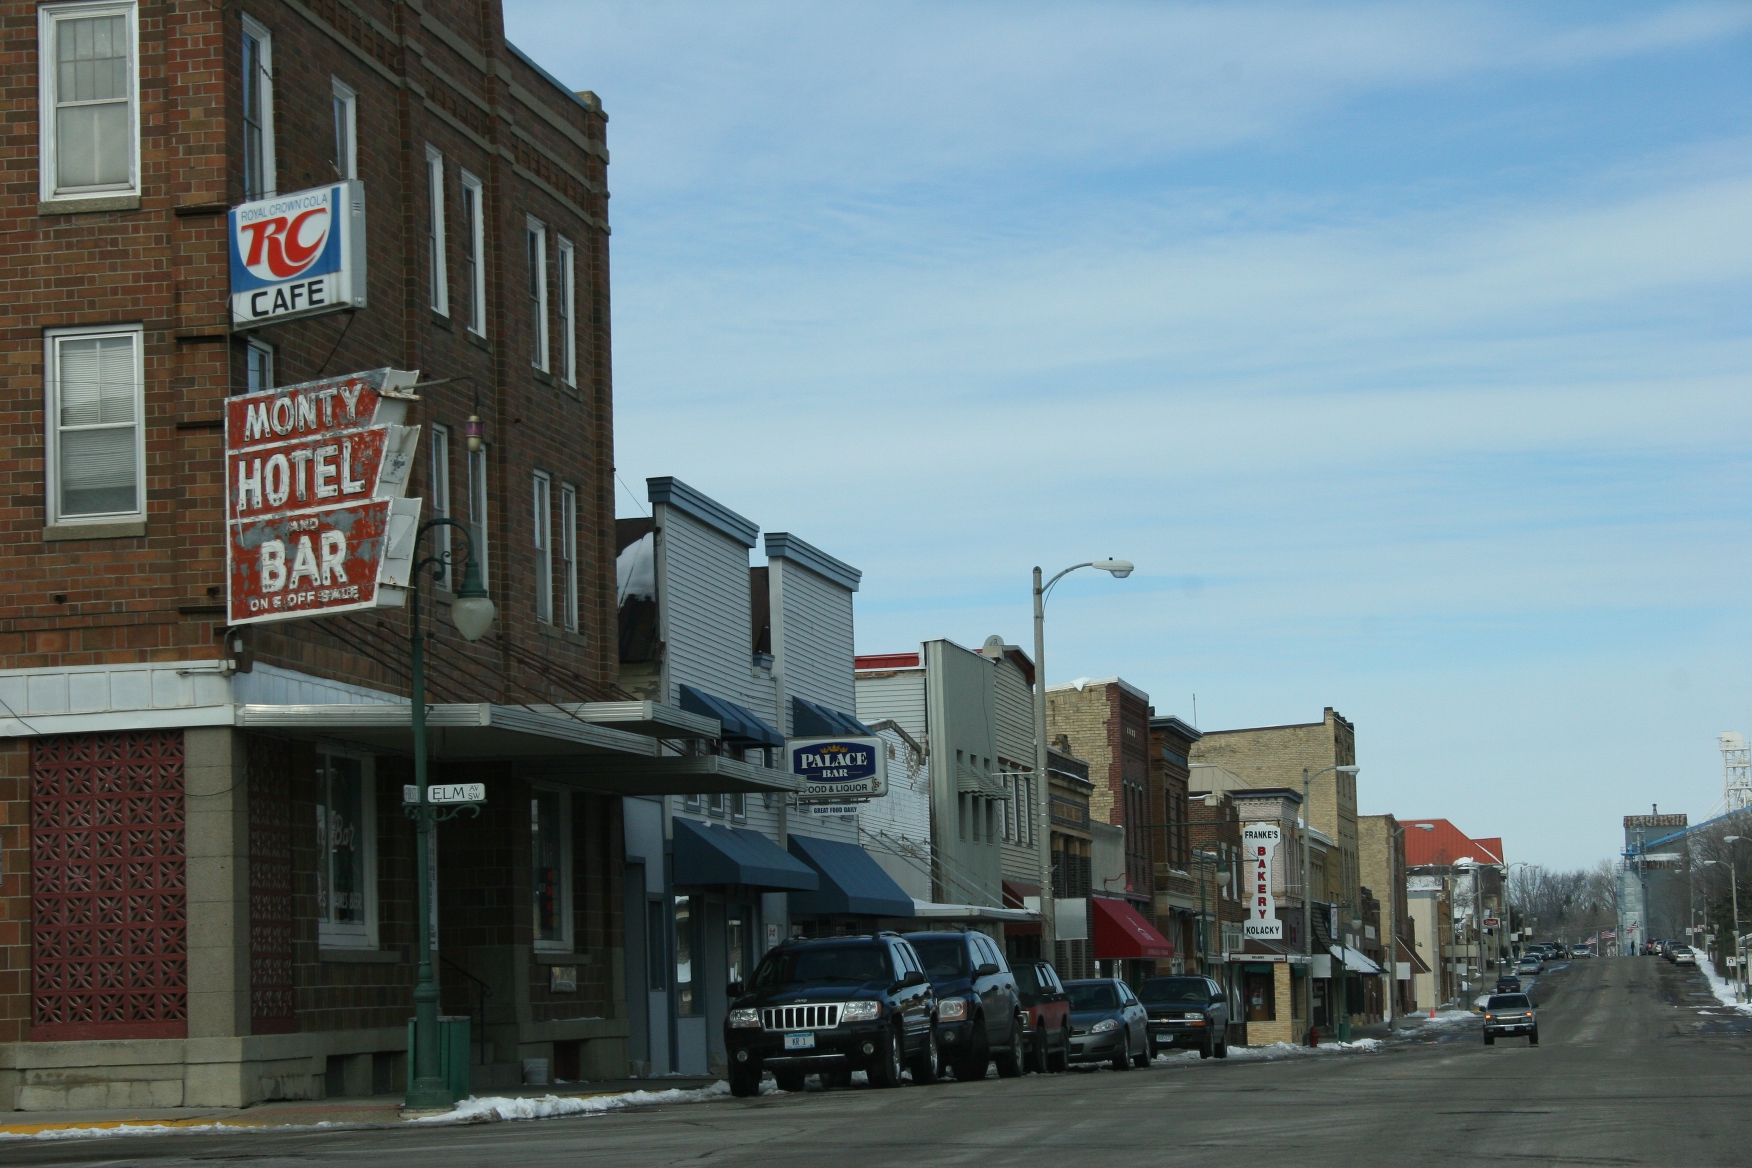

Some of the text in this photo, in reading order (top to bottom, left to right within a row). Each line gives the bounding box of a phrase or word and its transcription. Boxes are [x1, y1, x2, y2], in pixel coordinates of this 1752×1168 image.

[241, 193, 328, 222] ROYAL CROWN COLA
[240, 207, 328, 278] RC
[251, 279, 325, 318] CAFE
[244, 383, 363, 442] MONTY
[238, 440, 365, 511] HOTEL
[261, 529, 348, 593] BAR
[250, 597, 269, 611] ON
[287, 591, 316, 606] OFF
[801, 752, 866, 769] PALACE
[822, 769, 848, 778] BAR
[432, 787, 465, 800] ELM
[836, 784, 868, 793] LIQUOR
[1244, 830, 1279, 839] FRANKE'S
[1257, 846, 1267, 919] BAKERY
[1246, 926, 1280, 935] KOLACKY
